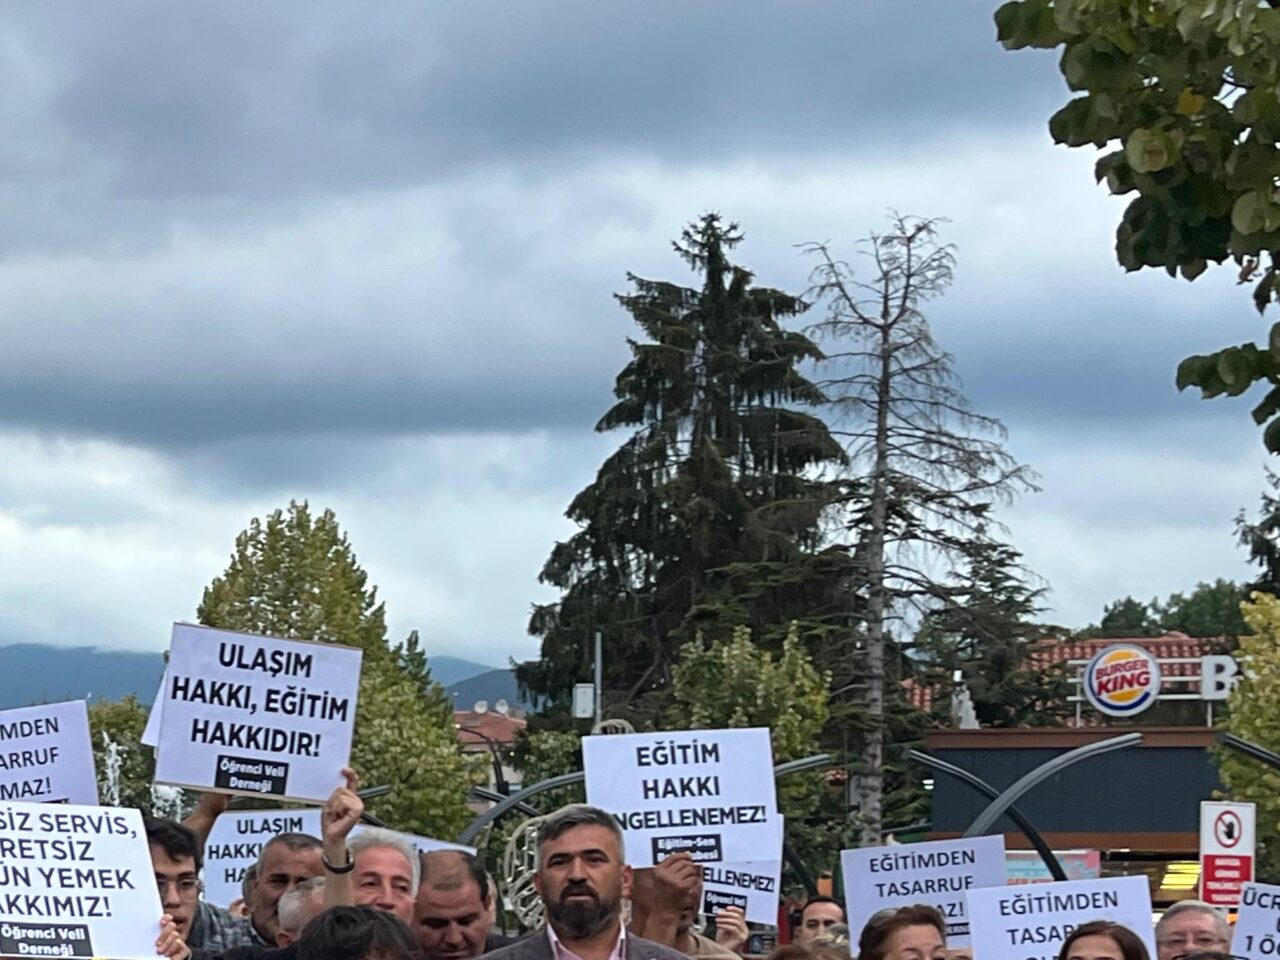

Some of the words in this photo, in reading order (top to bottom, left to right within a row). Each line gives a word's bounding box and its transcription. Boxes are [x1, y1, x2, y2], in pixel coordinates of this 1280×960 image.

[219, 642, 313, 678] ULAŞIM
[1095, 659, 1149, 680] BURGER
[1097, 671, 1151, 696] KING
[1202, 655, 1239, 700] B
[171, 676, 257, 715] HAKKI,
[264, 685, 349, 722] EĞİTİM
[191, 718, 322, 757] HAKKIDIR!
[636, 739, 719, 767] EĞİTİM
[220, 757, 263, 775] Öğrenci
[264, 764, 286, 779] Veli
[229, 776, 272, 793] Derneği
[642, 776, 720, 800] HAKKI
[40, 811, 138, 839] SERVİS,
[237, 817, 303, 836] ULAŞIM
[613, 805, 767, 831] NGELLENEMEZ!
[870, 849, 976, 873] EĞİTİMDEN
[37, 867, 136, 890] YEMEK
[875, 875, 974, 898] TASARRUF
[999, 891, 1118, 916] EĞİTİMDEN
[1, 924, 56, 942] Öğrenci
[59, 926, 86, 941] Veli
[18, 942, 75, 957] Derneği
